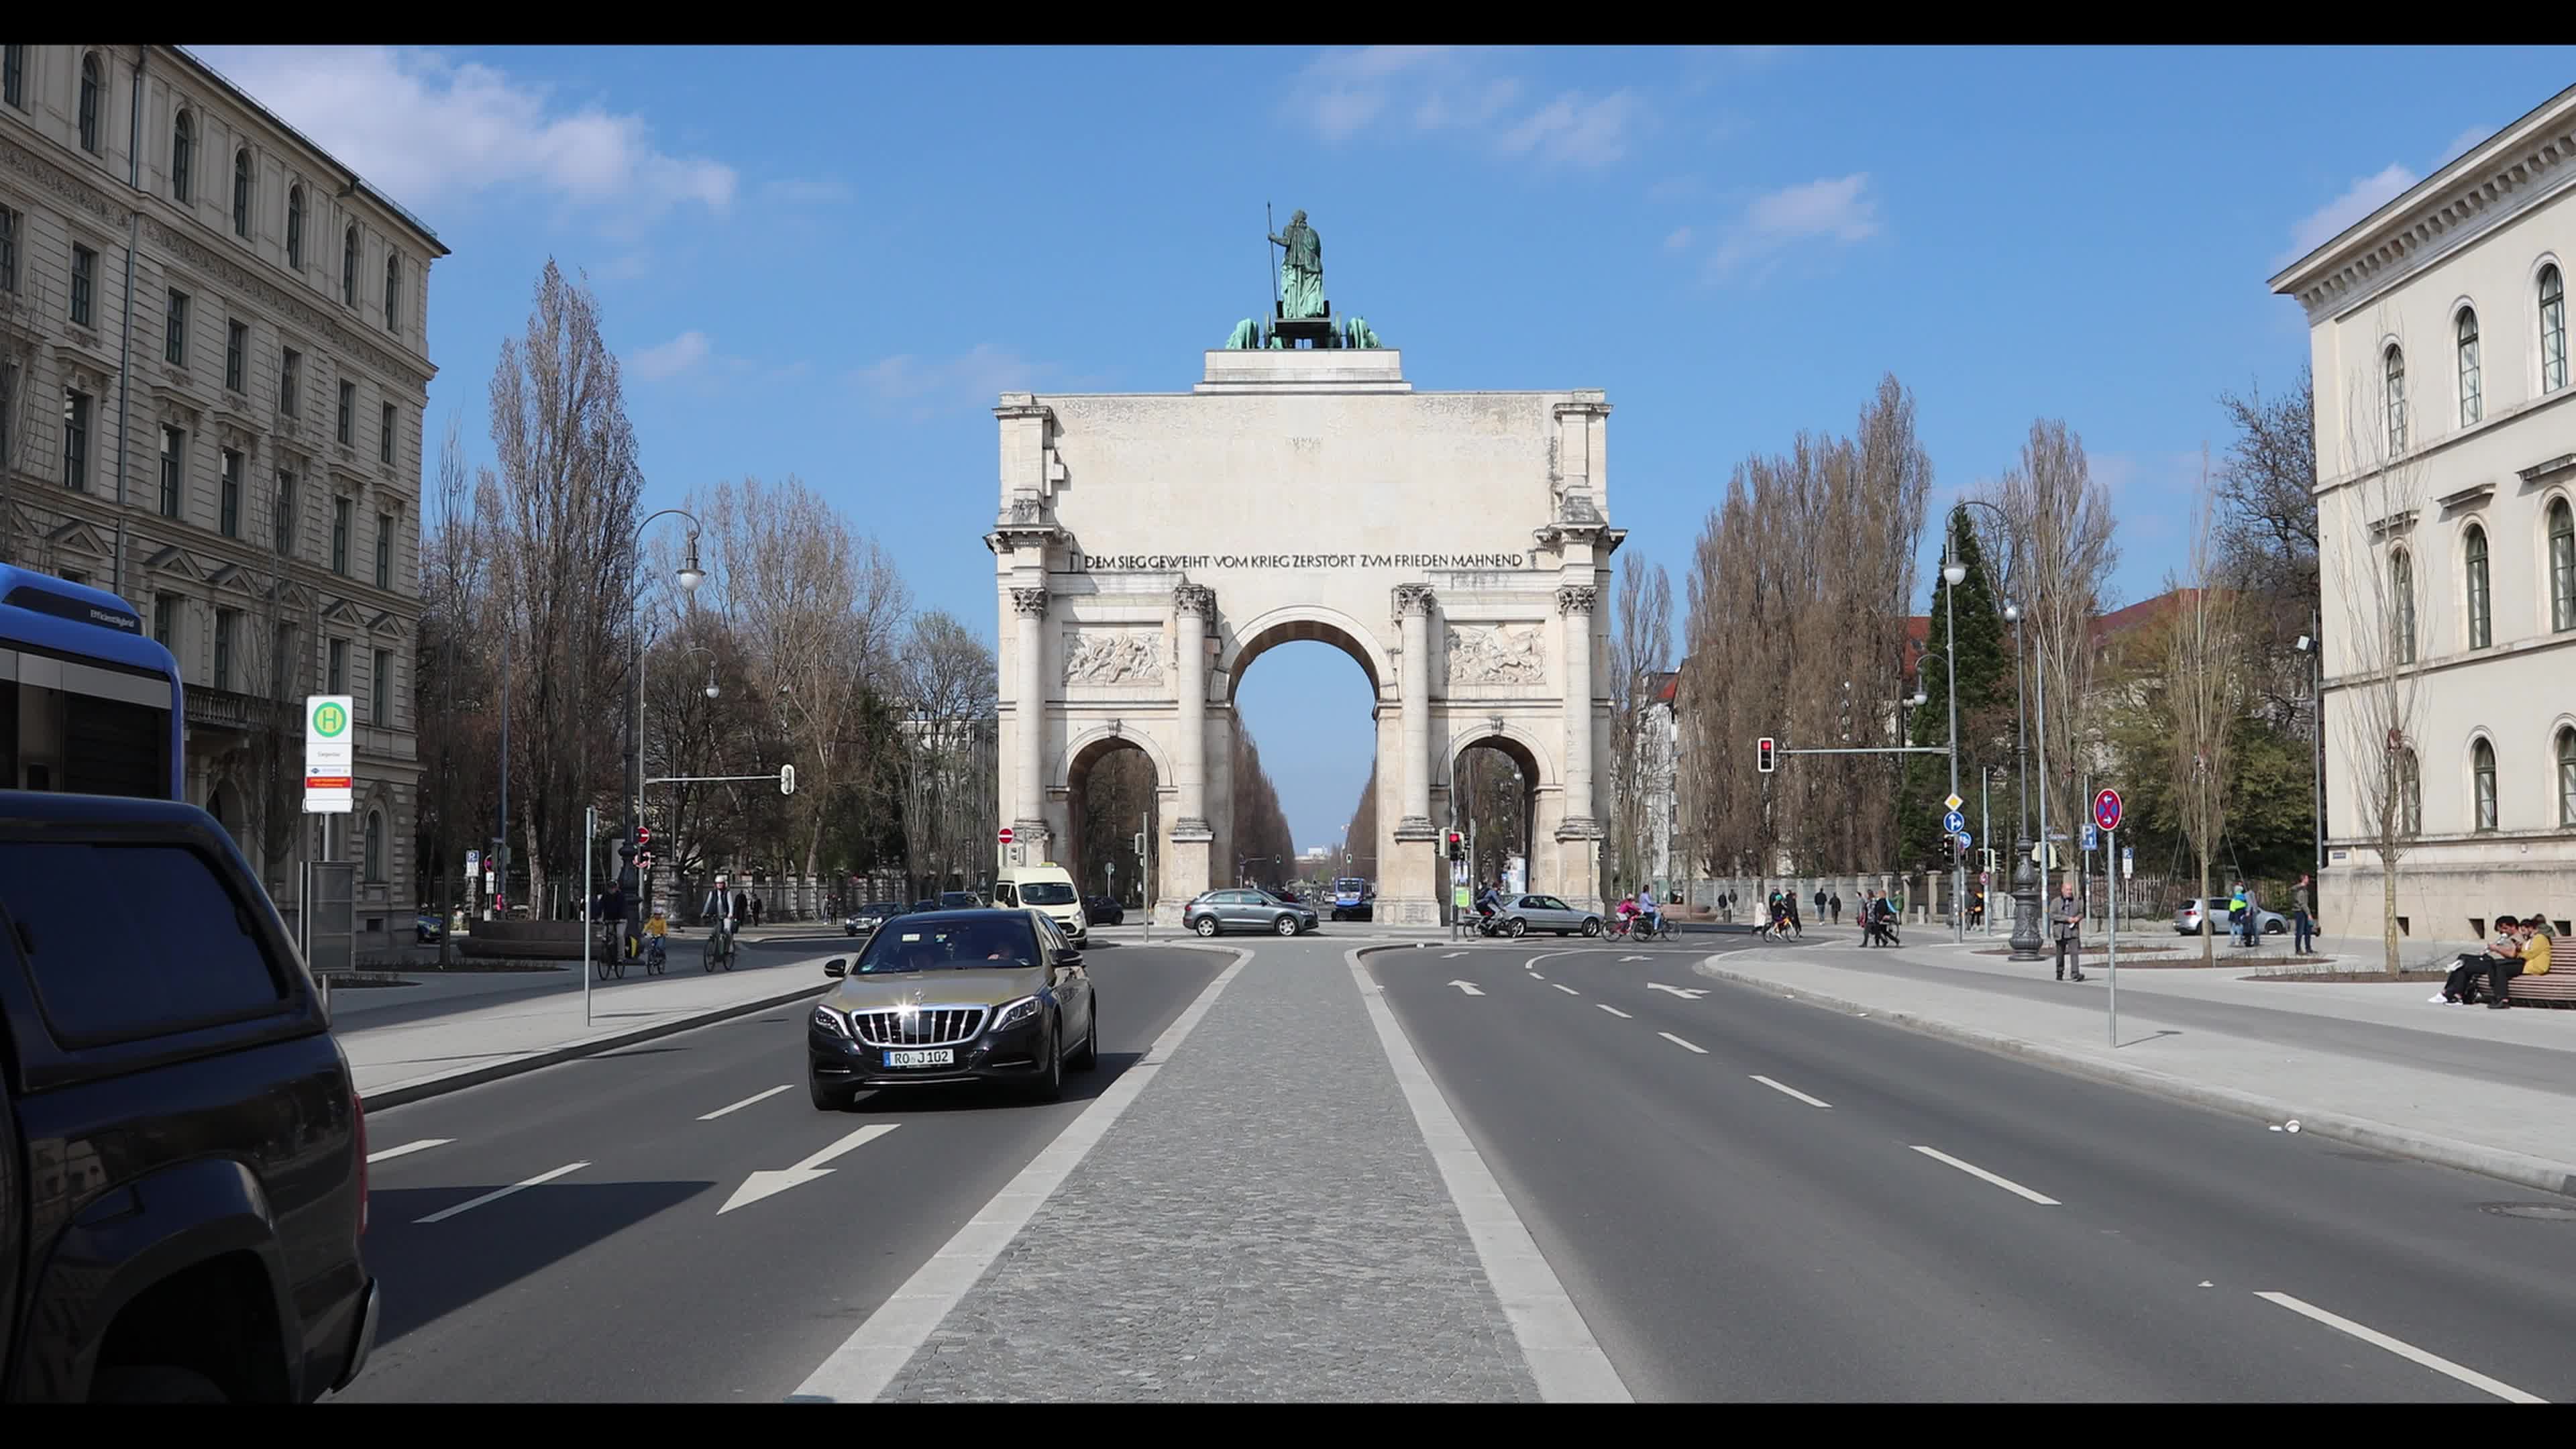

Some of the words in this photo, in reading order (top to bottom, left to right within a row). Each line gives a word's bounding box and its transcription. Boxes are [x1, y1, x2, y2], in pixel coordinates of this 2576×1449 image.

[1085, 555, 1115, 568] DEM
[1118, 555, 1146, 568] SIEG
[1148, 555, 1210, 568] GEWEIHT
[1214, 555, 1248, 568] VOM
[1251, 555, 1289, 568] KRIEG
[1361, 555, 1391, 567] ZVM
[1395, 555, 1448, 567] FRIEDEN
[1451, 554, 1522, 567] MAHNEND
[322, 710, 337, 729] H
[895, 1053, 910, 1064] RO
